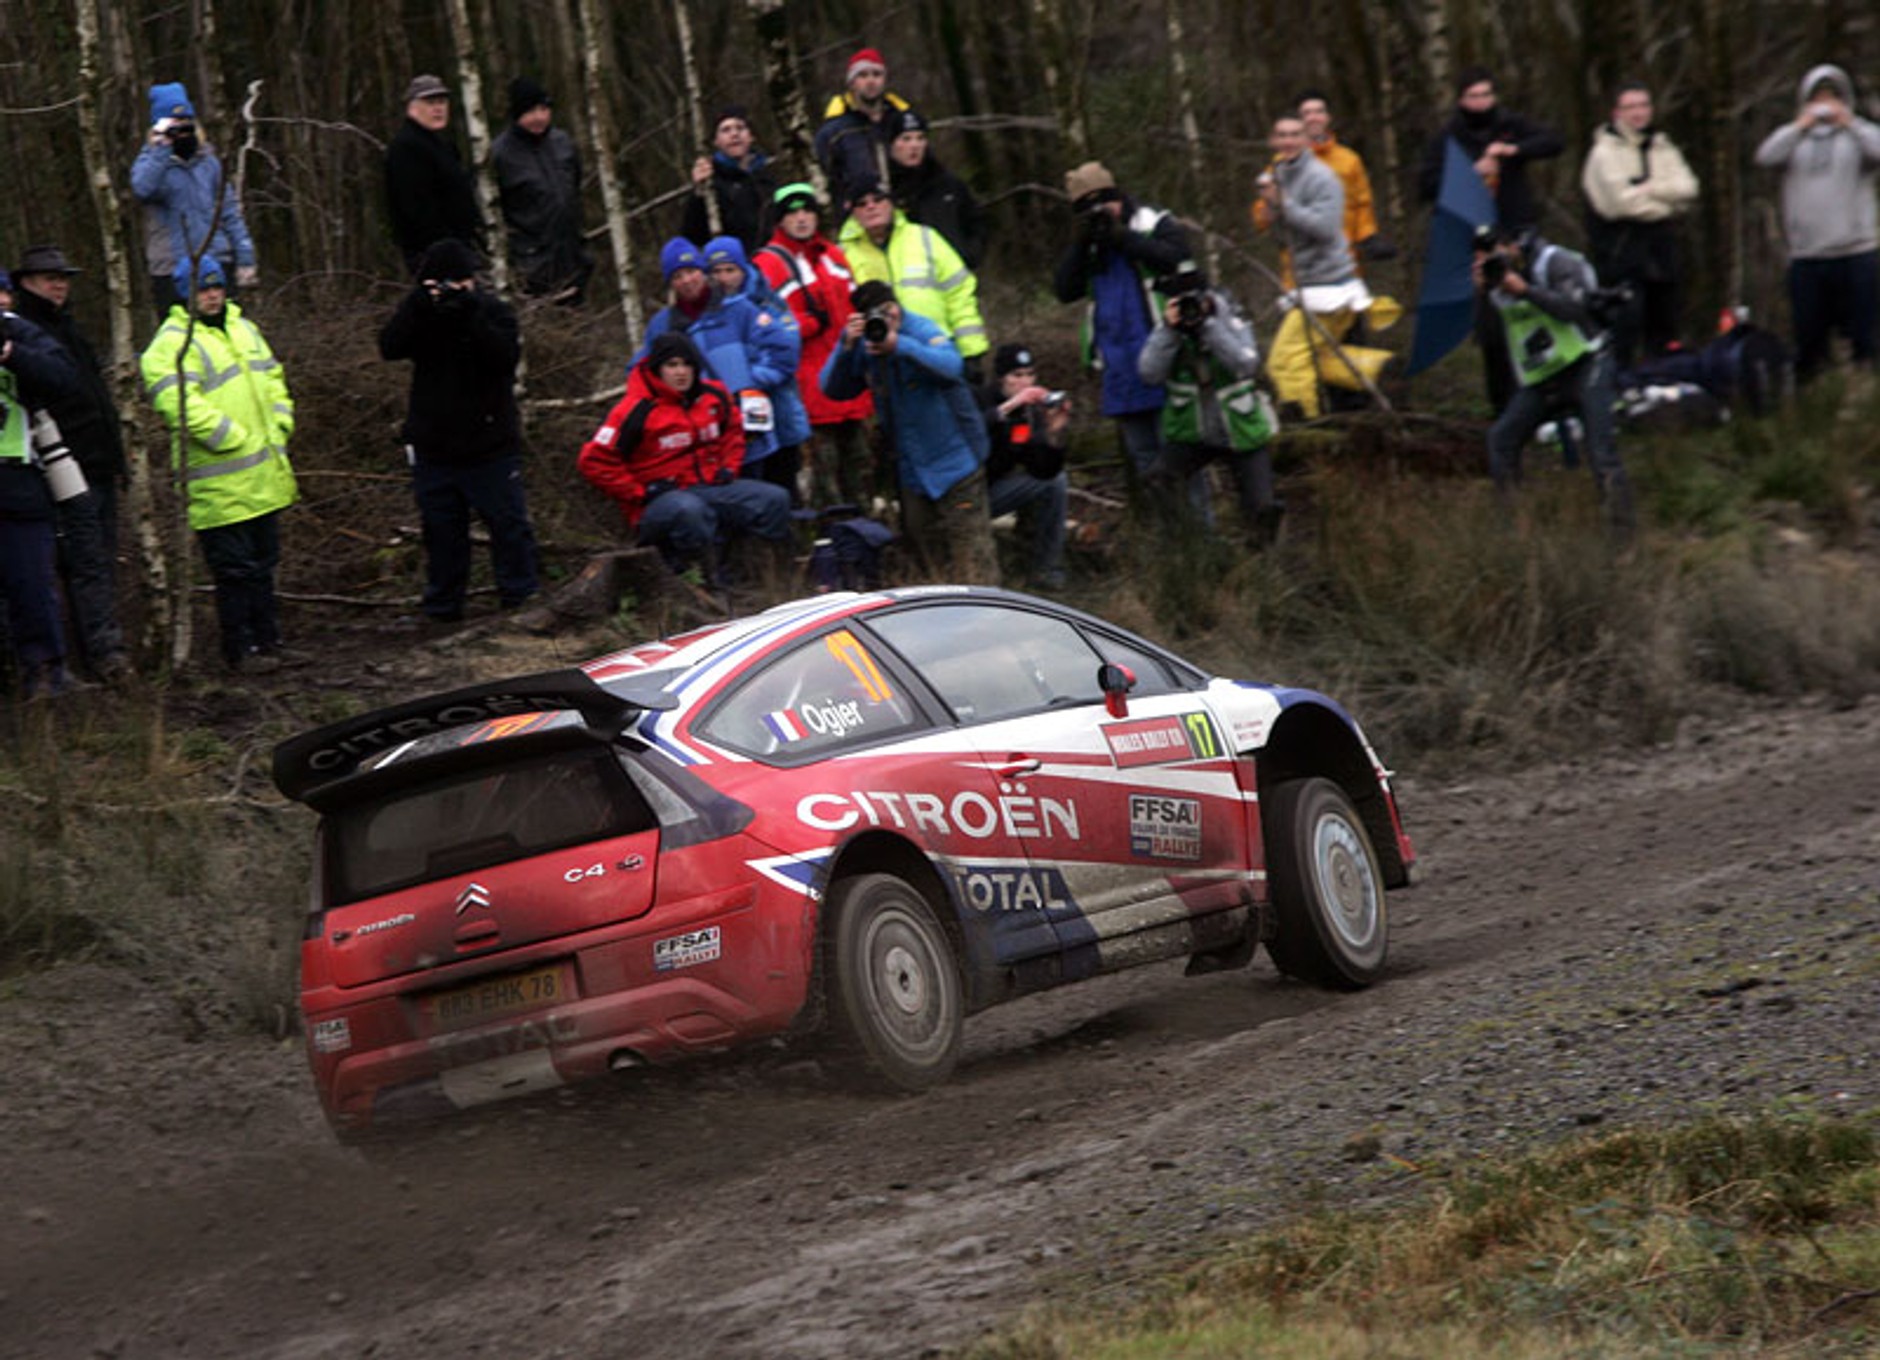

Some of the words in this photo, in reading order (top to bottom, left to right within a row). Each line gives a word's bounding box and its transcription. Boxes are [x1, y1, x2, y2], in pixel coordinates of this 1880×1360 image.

[825, 630, 893, 703] 17
[801, 697, 864, 737] Ogier
[1186, 713, 1216, 758] 17
[796, 782, 1080, 840] CITROËN
[1132, 799, 1192, 825] FFSA
[1153, 837, 1199, 857] RALLYE
[564, 863, 606, 882] C4
[656, 931, 711, 954] FFSA
[529, 974, 556, 999] 78
